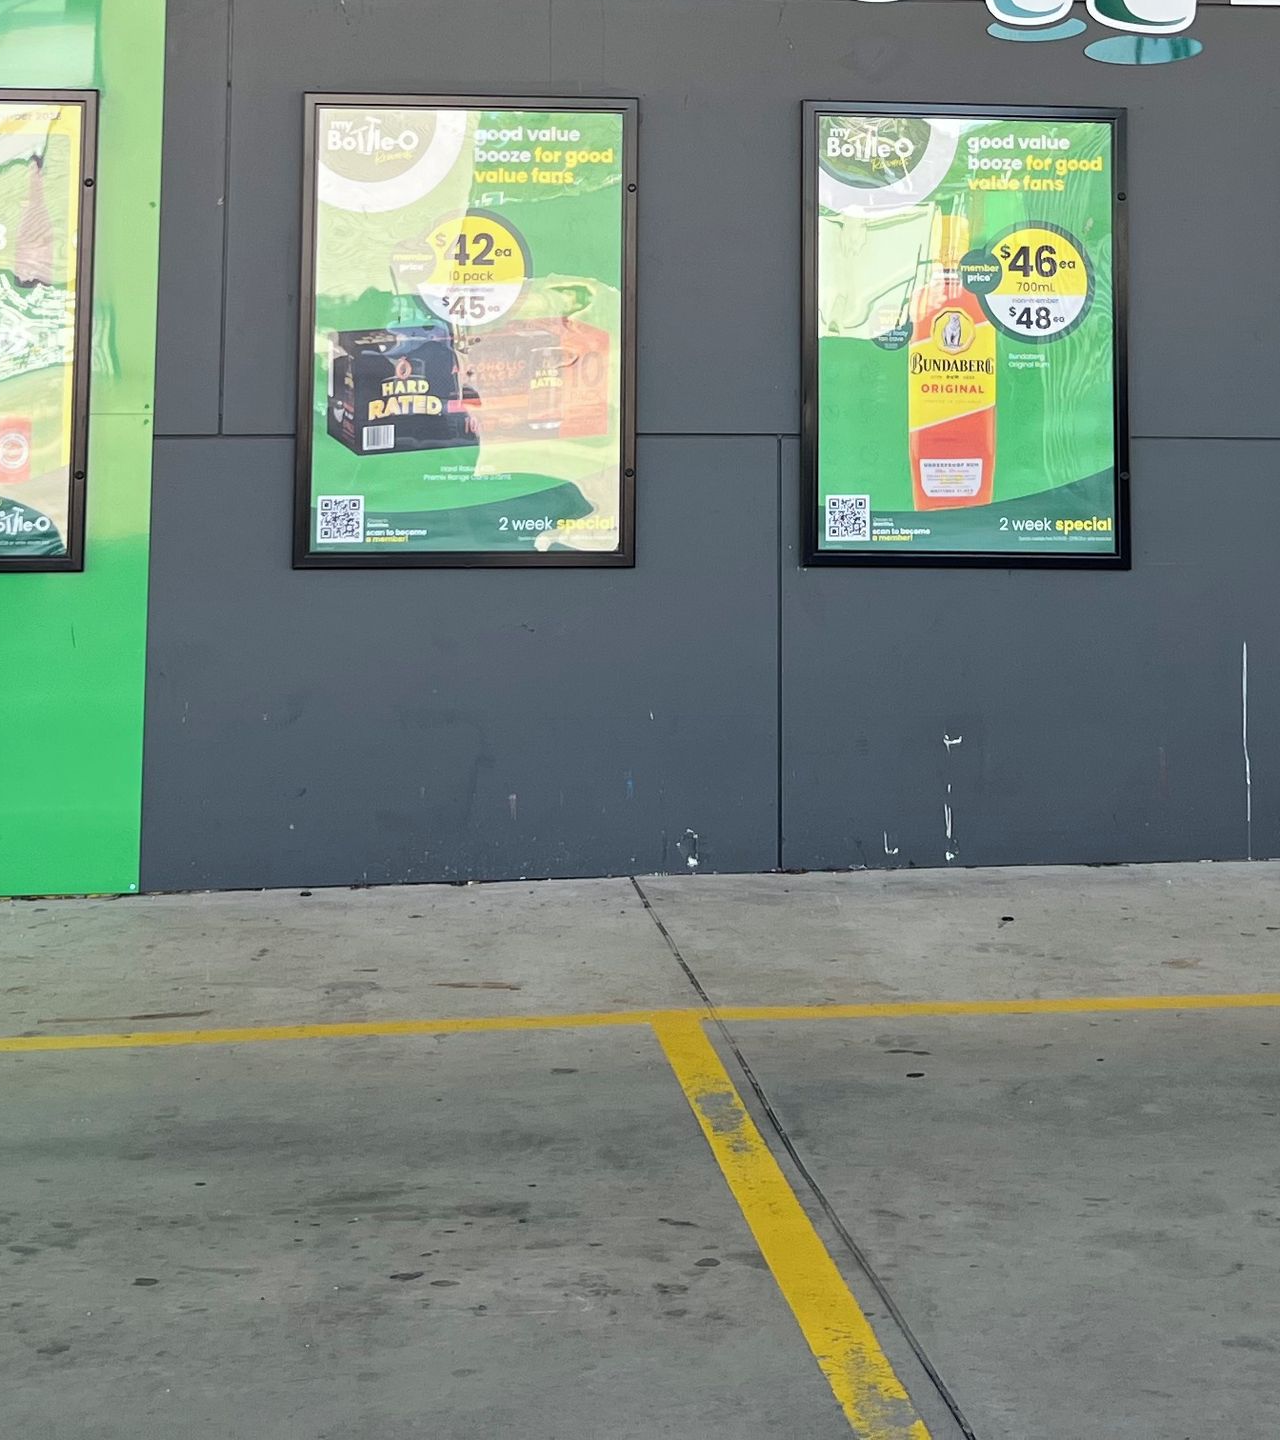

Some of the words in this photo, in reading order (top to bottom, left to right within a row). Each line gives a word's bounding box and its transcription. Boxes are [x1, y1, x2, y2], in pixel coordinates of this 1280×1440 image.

[328, 116, 419, 155] Bottle-O
[331, 119, 352, 133] my
[830, 127, 851, 140] my
[474, 127, 523, 147] good
[527, 127, 581, 143] value
[827, 125, 914, 162] Bottle-O
[967, 134, 1014, 153] good
[1018, 135, 1071, 151] value
[474, 147, 531, 163] booze
[535, 147, 561, 163] for
[565, 148, 614, 167] good
[968, 155, 1023, 171] booze
[1025, 155, 1053, 171] for
[1056, 155, 1103, 175] good
[474, 168, 529, 184] value
[531, 168, 575, 184] fans
[967, 175, 1020, 191] value
[1023, 175, 1065, 191] fans
[435, 232, 495, 266] $42
[494, 248, 512, 257] ea
[960, 264, 1000, 273] member
[1000, 244, 1058, 278] $46
[1058, 259, 1076, 269] ea
[463, 271, 494, 284] pack
[1016, 282, 1056, 293] 700mL
[442, 295, 486, 319] $45
[1009, 306, 1052, 330] $48
[910, 352, 994, 375] BUNDABERG
[381, 380, 430, 397] HARD
[921, 384, 985, 394] ORIGINAL
[368, 395, 443, 421] RATED
[499, 517, 509, 531] 2
[512, 516, 553, 531] week
[556, 516, 615, 535] special
[1000, 517, 1009, 531] 2
[1012, 517, 1052, 531] week
[1055, 517, 1112, 536] special
